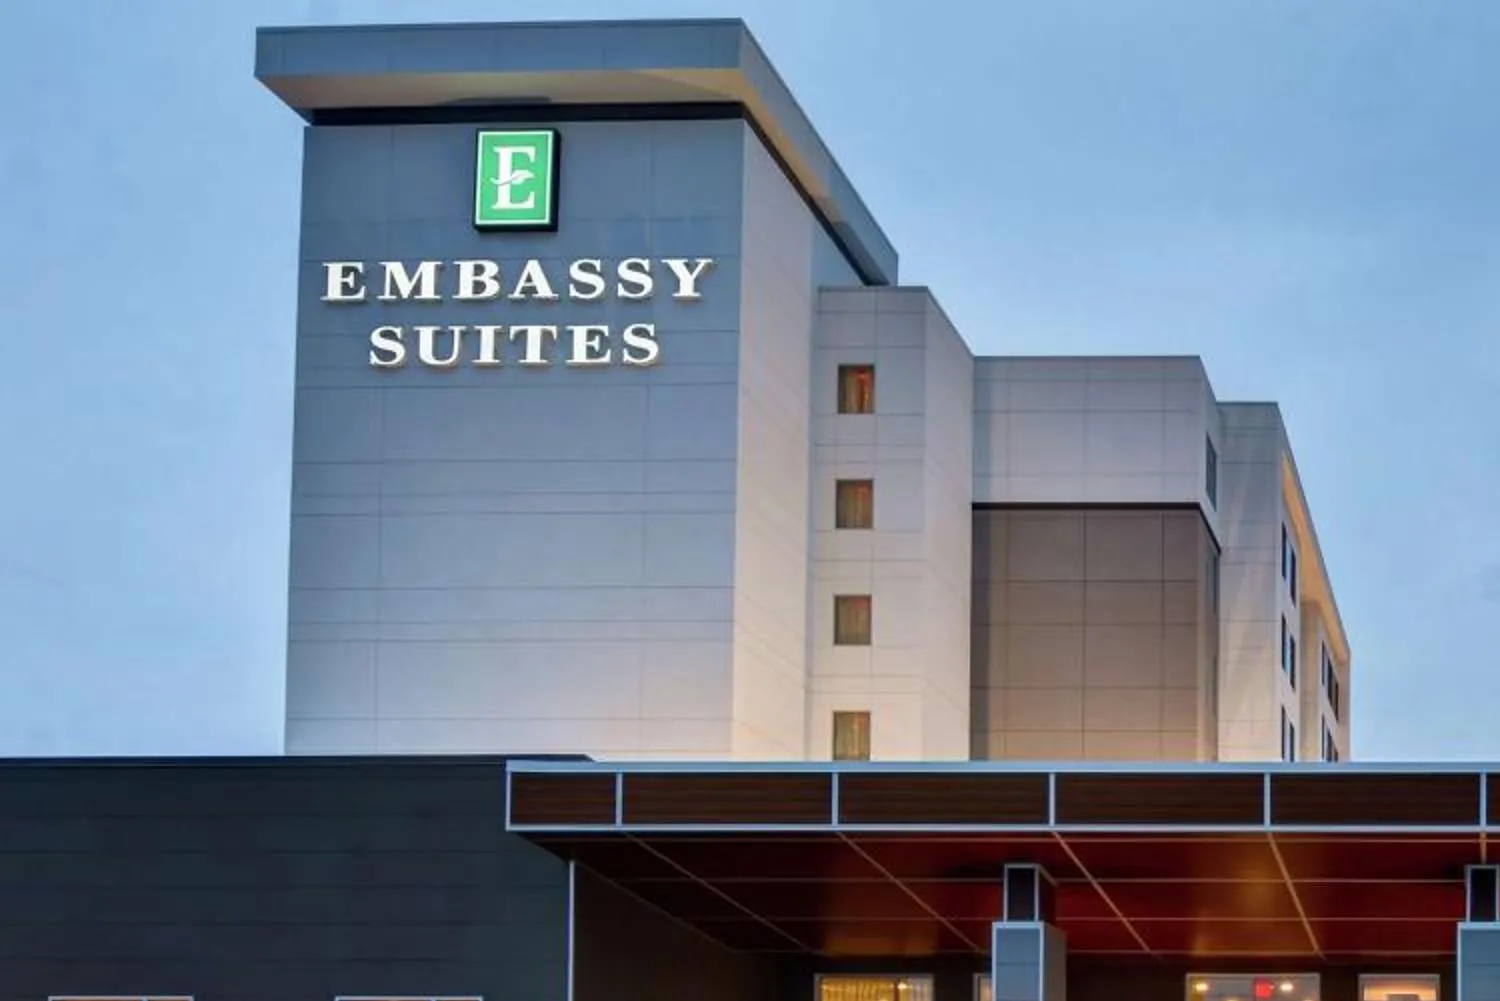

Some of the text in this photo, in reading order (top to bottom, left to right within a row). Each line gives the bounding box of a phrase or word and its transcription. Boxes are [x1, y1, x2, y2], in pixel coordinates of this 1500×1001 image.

[491, 145, 536, 210] E
[321, 257, 712, 301] EMBASSY
[369, 323, 659, 365] SUITES
